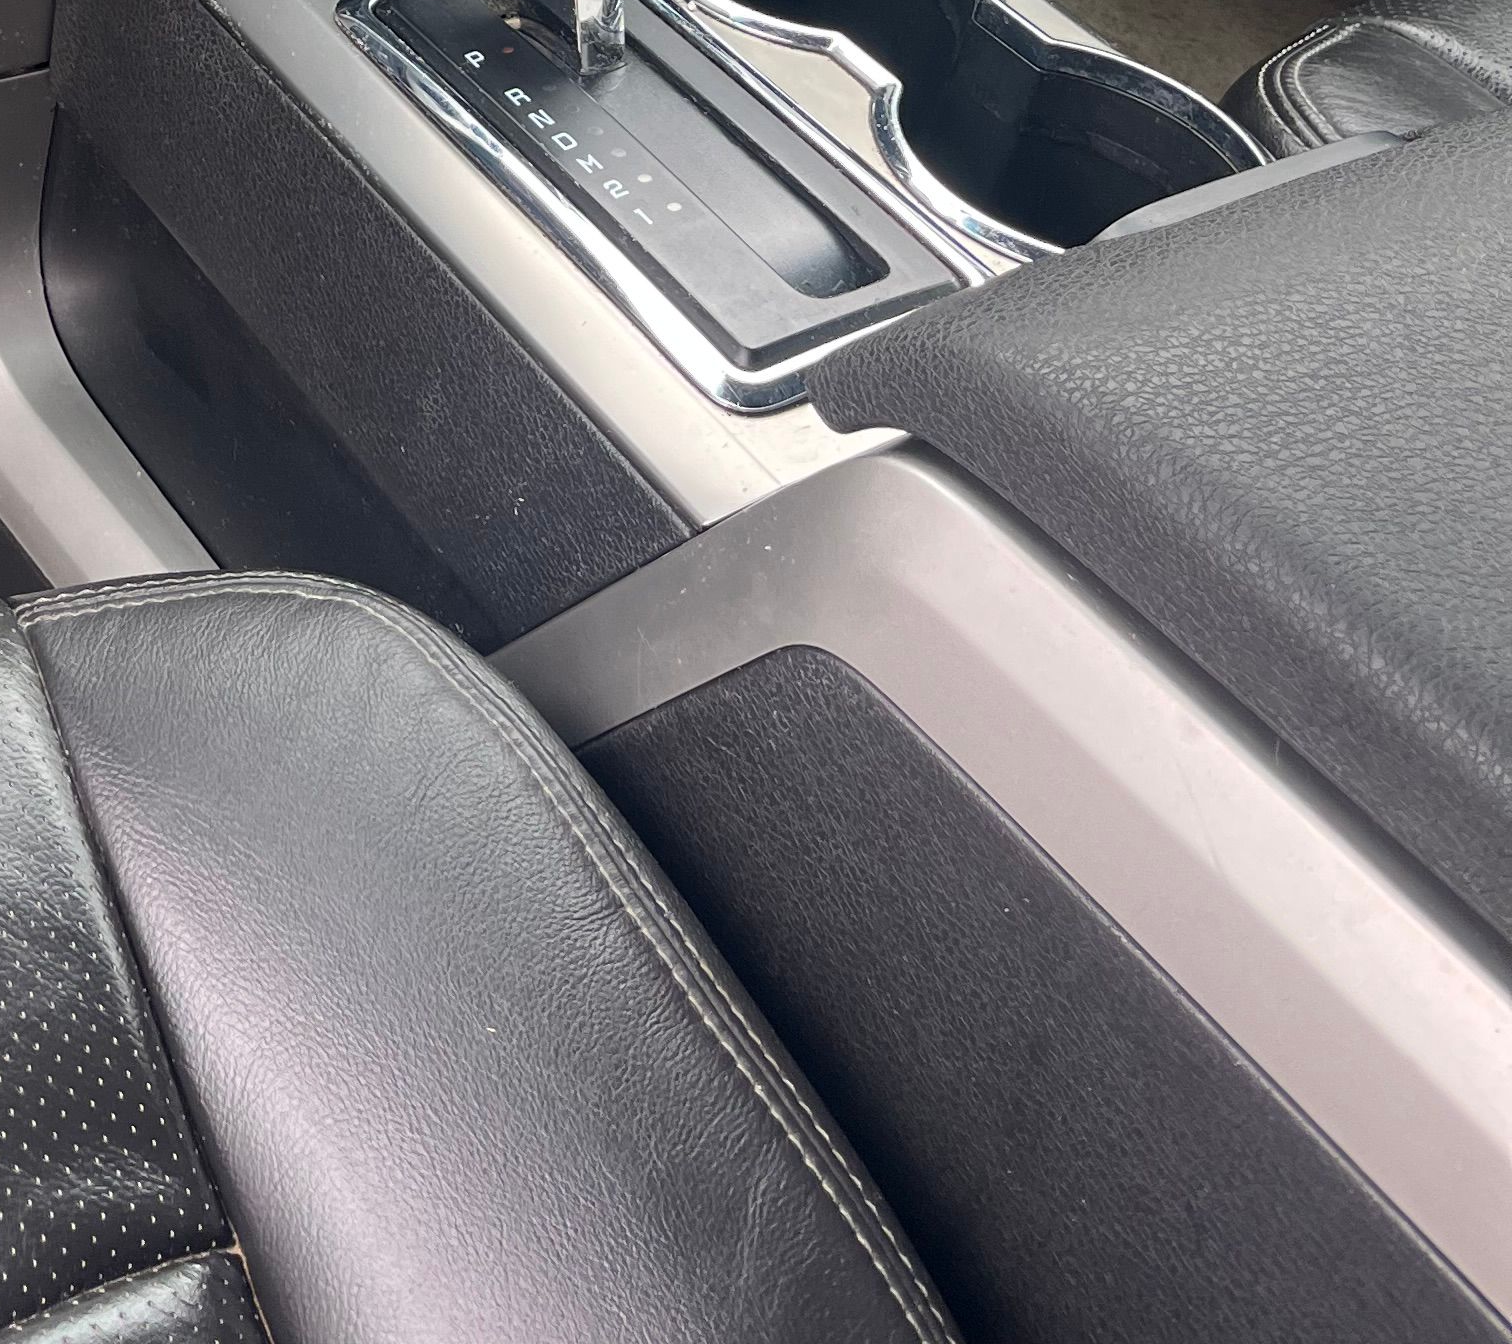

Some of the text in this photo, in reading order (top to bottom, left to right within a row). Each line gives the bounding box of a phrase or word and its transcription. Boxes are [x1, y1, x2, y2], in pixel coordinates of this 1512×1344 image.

[464, 50, 653, 225] P R N D M 2 1
